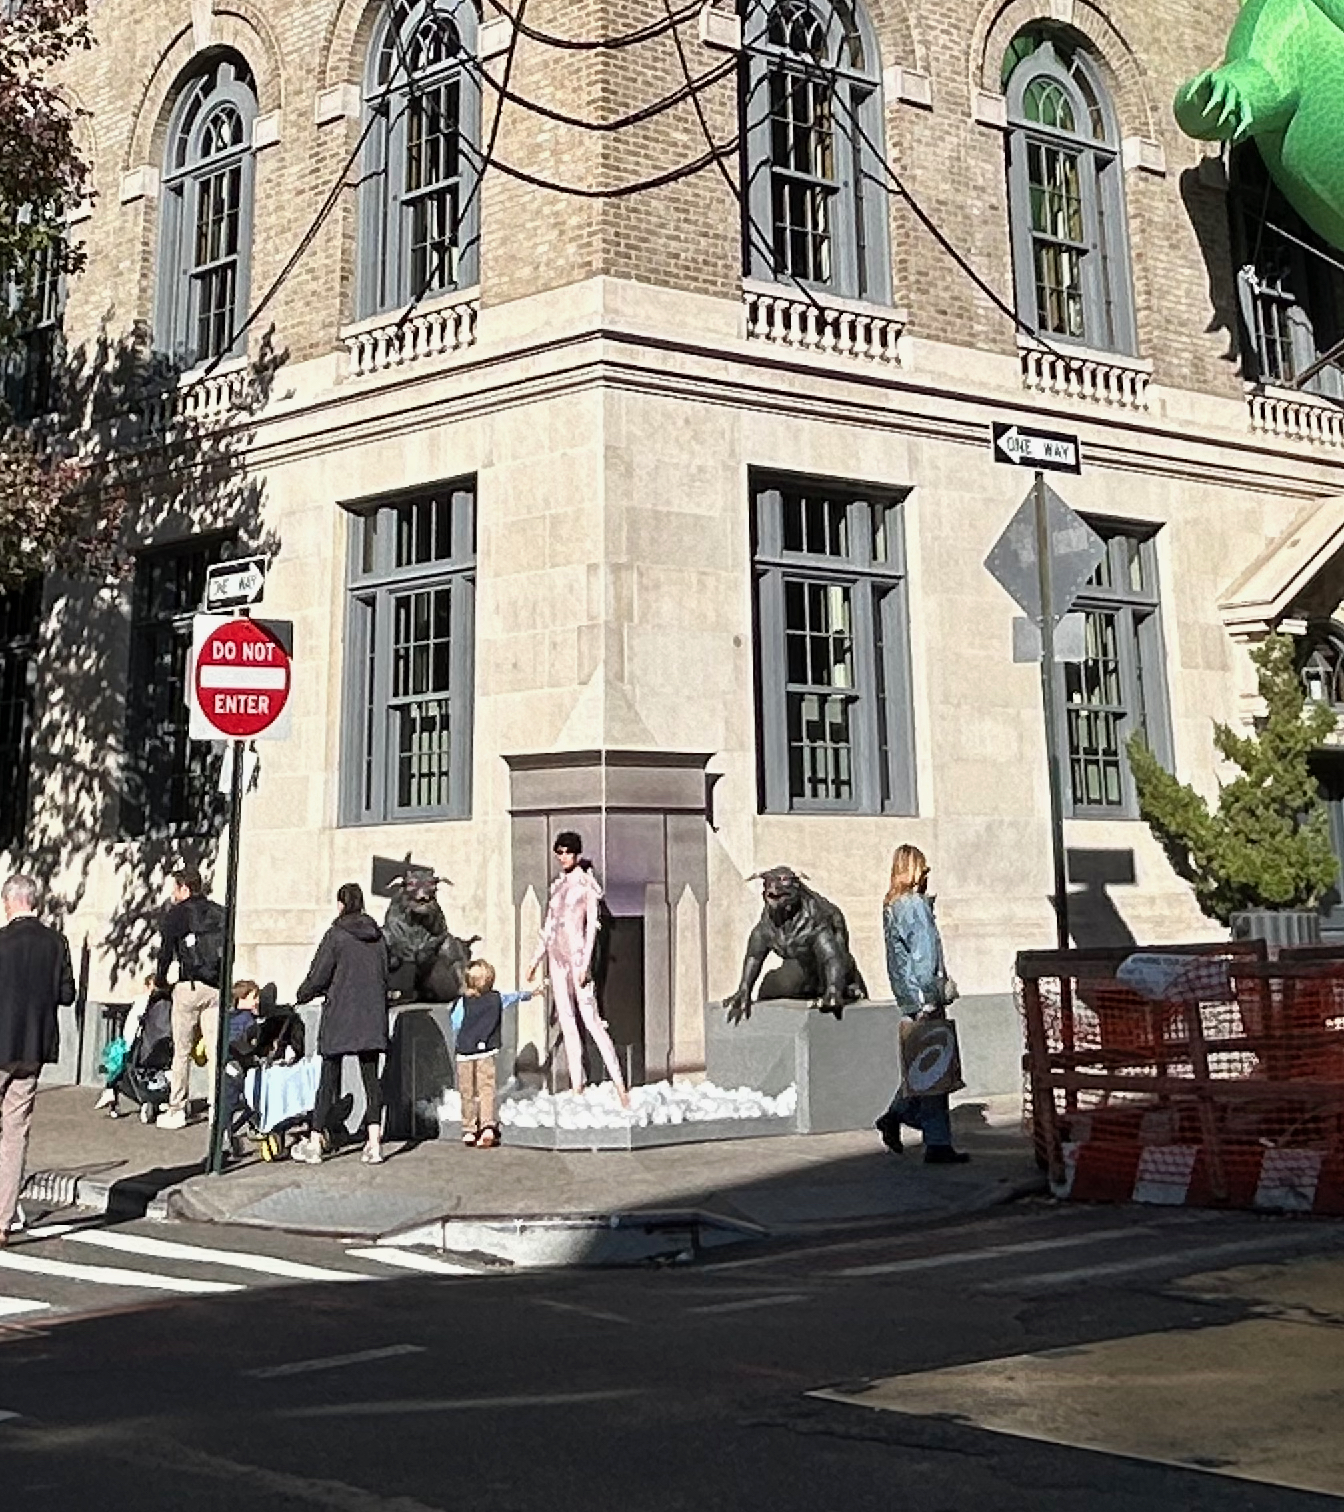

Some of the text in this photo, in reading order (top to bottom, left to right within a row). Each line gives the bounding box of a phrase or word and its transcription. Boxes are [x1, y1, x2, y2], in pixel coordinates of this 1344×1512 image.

[1006, 436, 1069, 460] ONE WAY
[212, 640, 276, 662] DO NOT
[214, 693, 270, 715] ENTER
